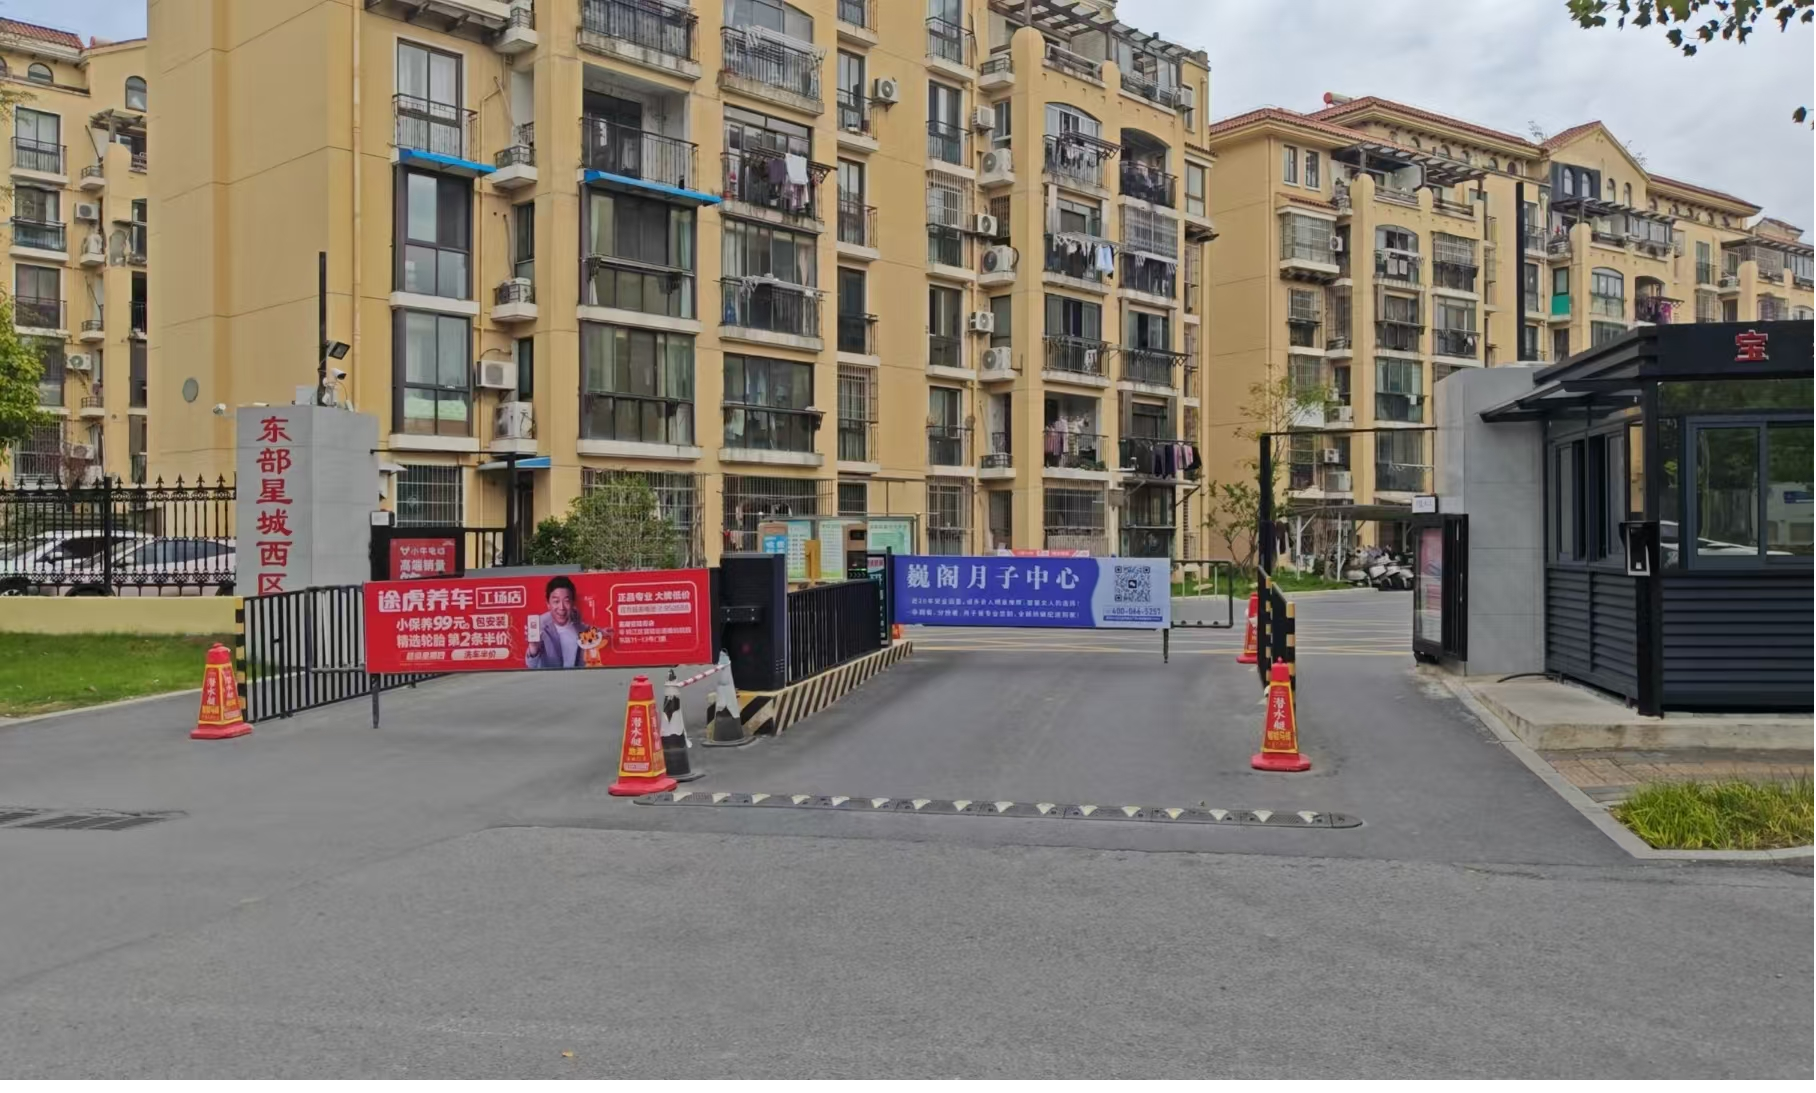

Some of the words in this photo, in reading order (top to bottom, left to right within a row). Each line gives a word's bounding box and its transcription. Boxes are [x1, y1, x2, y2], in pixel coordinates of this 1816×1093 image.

[1735, 329, 1769, 362] 宝
[256, 415, 293, 596] 东部星城西区
[400, 559, 446, 572] 高端销量
[907, 563, 1080, 591] 巍阁月子中心
[378, 588, 474, 613] 途虎养车
[480, 590, 522, 606] 工场店
[476, 616, 507, 628] 包安装
[396, 634, 445, 648] 精选轮胎
[448, 631, 509, 648] 第2条半价
[464, 650, 497, 660] 洗车半价
[1273, 696, 1286, 730] 潜水艇
[631, 717, 643, 746] 潜水艇
